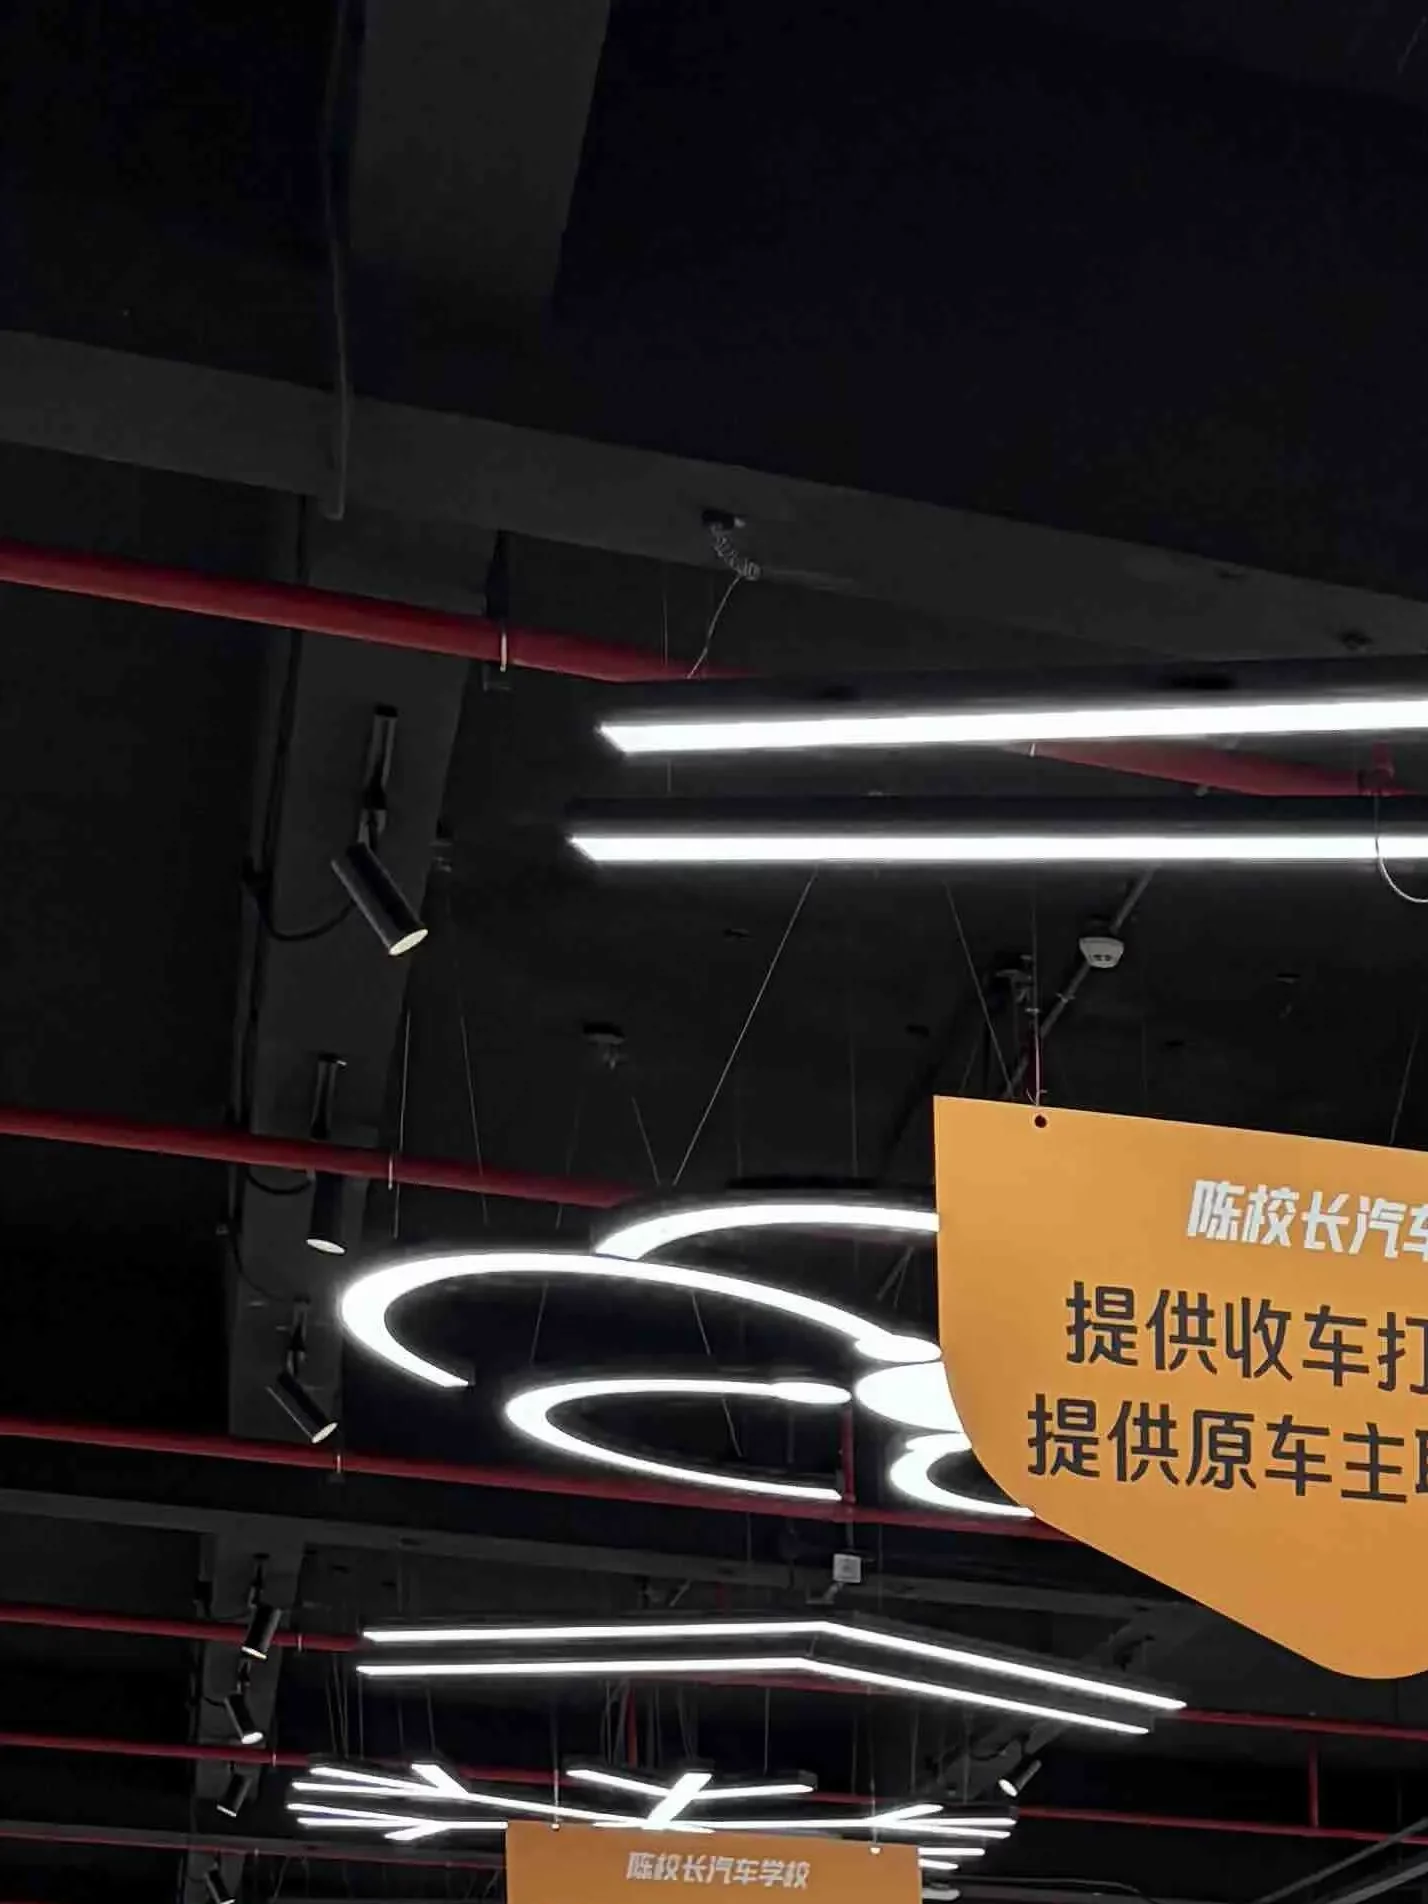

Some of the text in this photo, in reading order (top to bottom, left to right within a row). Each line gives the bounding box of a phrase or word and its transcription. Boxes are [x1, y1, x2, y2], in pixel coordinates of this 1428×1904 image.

[627, 1852, 810, 1890] 陈校长汽车学校
